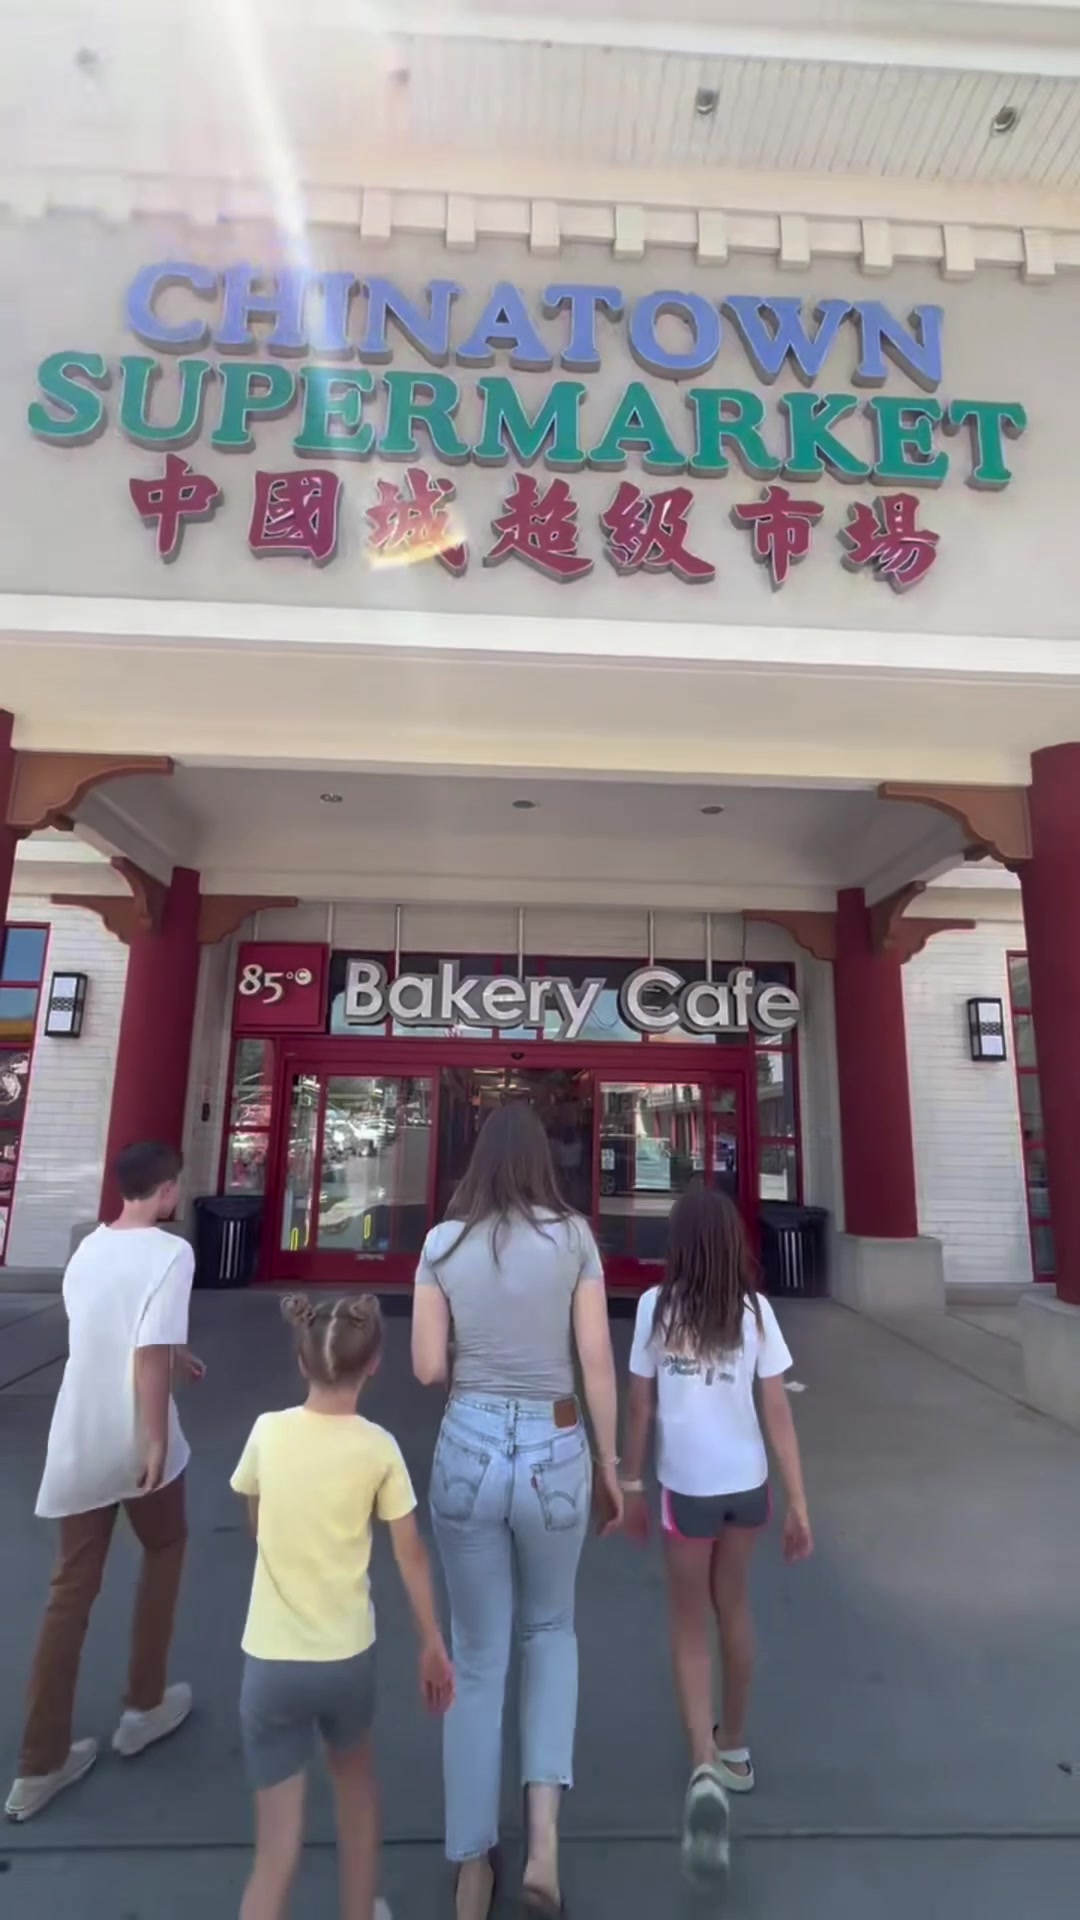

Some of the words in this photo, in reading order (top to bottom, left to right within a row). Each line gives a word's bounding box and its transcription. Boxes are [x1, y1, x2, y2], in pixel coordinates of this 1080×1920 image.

[126, 261, 945, 391] CHINATOWN
[28, 351, 1026, 490] SUPERMARKET
[128, 453, 940, 592] 中國城超級市場
[344, 957, 606, 1041] Bakery
[617, 964, 802, 1036] Cafe
